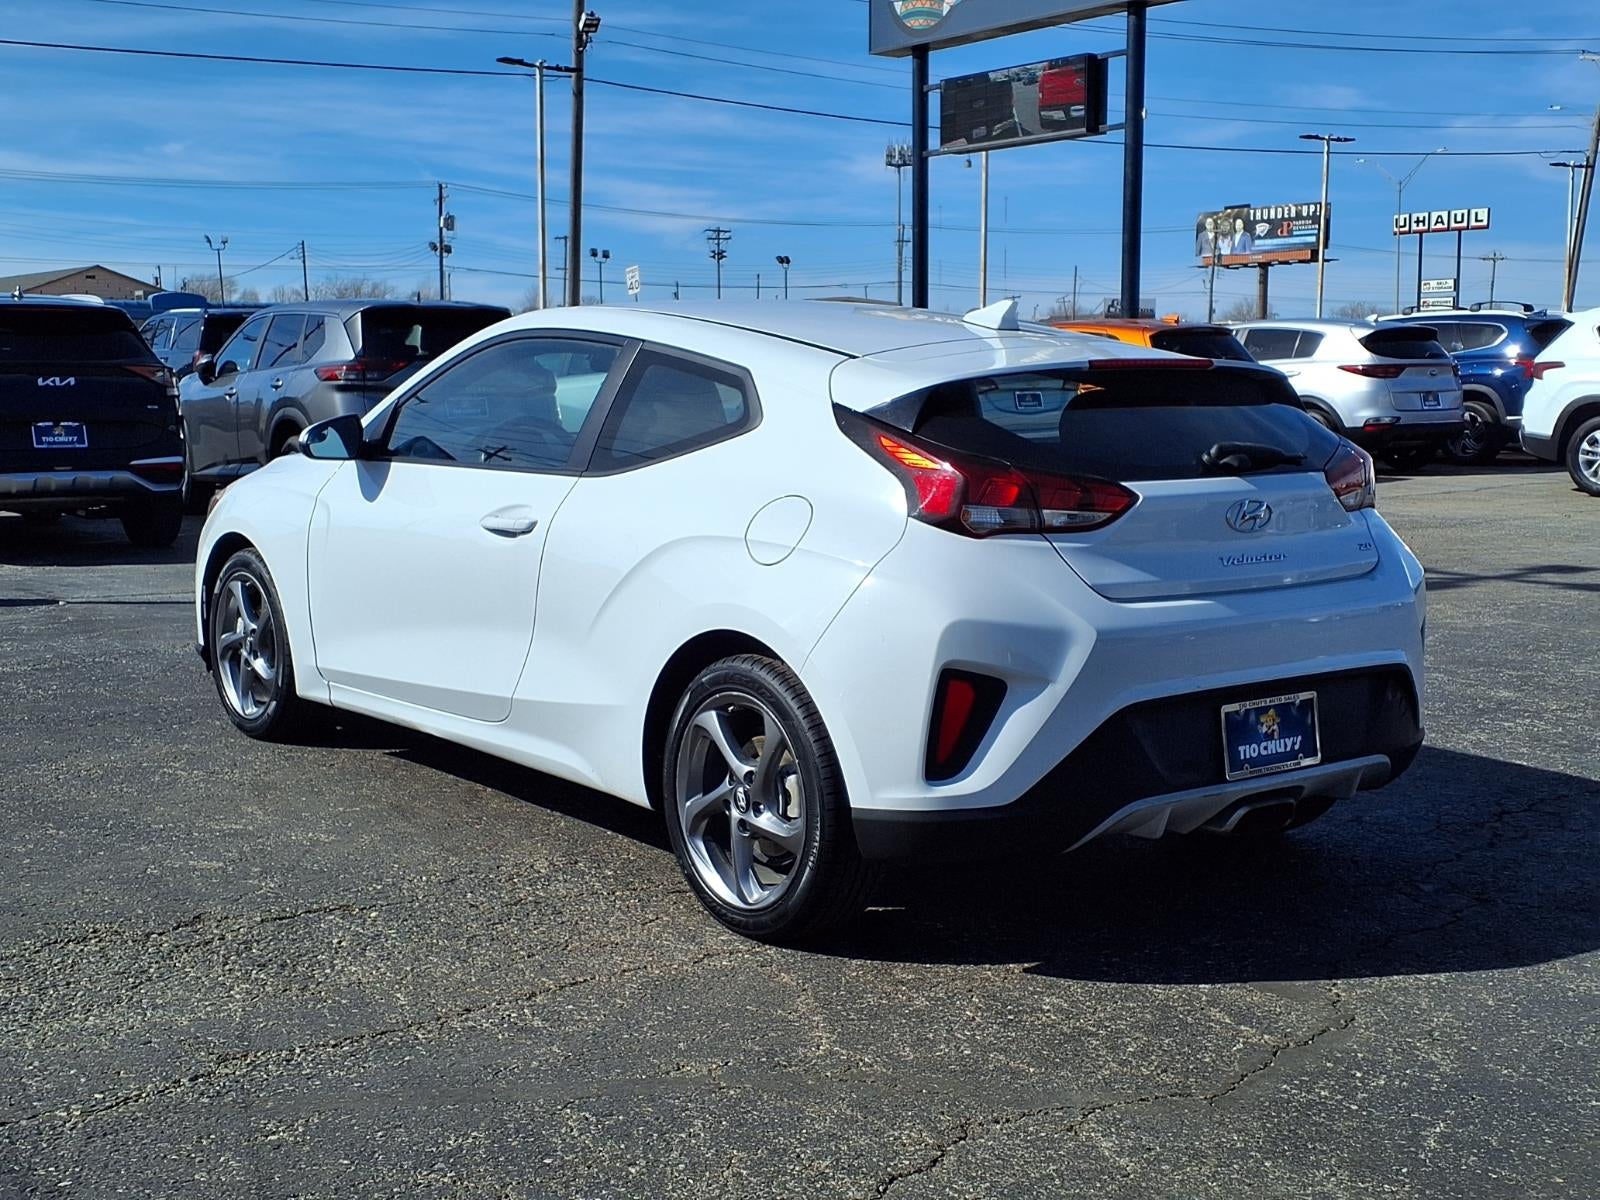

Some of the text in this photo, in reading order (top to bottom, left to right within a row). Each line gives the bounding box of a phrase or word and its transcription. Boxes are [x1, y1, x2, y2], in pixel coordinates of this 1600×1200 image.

[1250, 204, 1321, 220] THUNDER UP!
[628, 279, 639, 290] 40
[37, 376, 75, 386] KIA
[1219, 552, 1287, 567] Veloster
[1284, 694, 1300, 702] SALES
[1238, 735, 1302, 760] TIO CHUY'S
